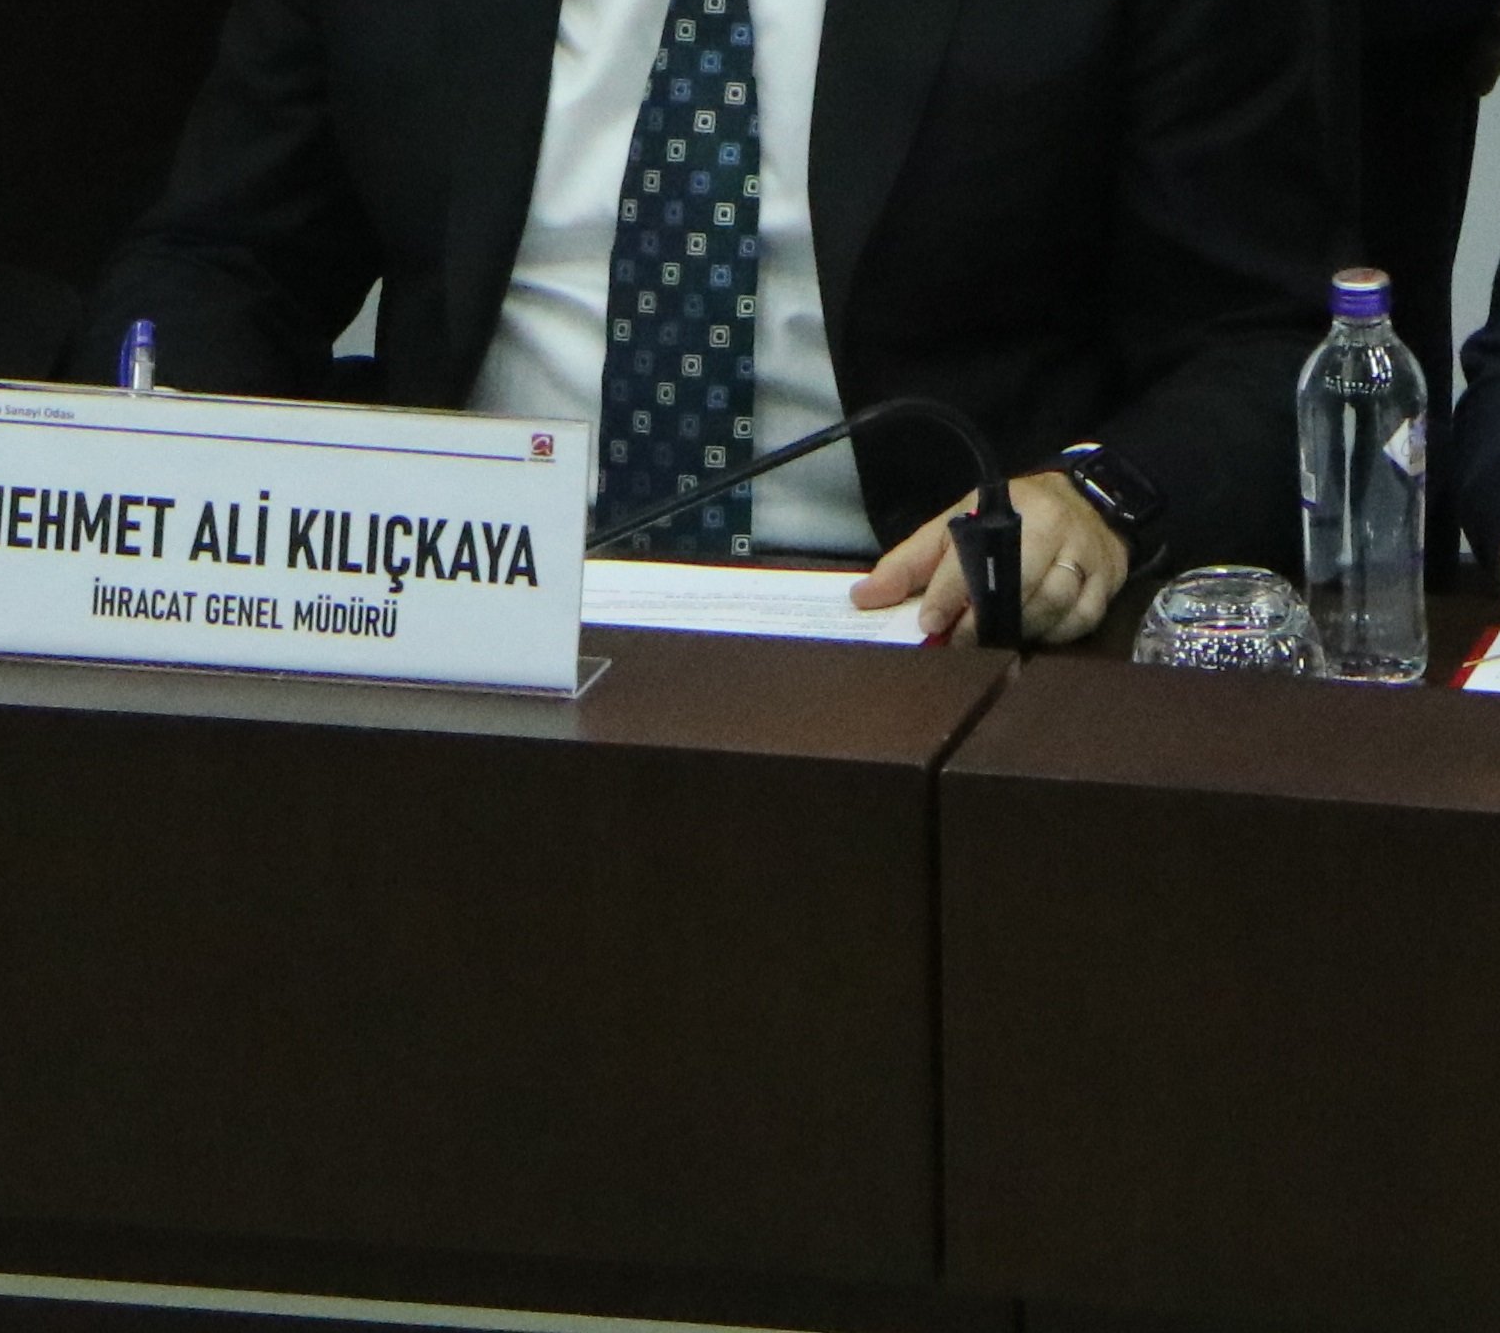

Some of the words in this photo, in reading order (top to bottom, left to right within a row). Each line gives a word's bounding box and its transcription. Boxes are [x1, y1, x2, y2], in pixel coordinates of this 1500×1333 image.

[188, 490, 270, 567] ALİ
[286, 507, 539, 595] KILIÇKAYA
[91, 576, 197, 624] İHRACAT
[204, 593, 283, 630] GENEL
[293, 595, 398, 639] MÜDÜRÜ
